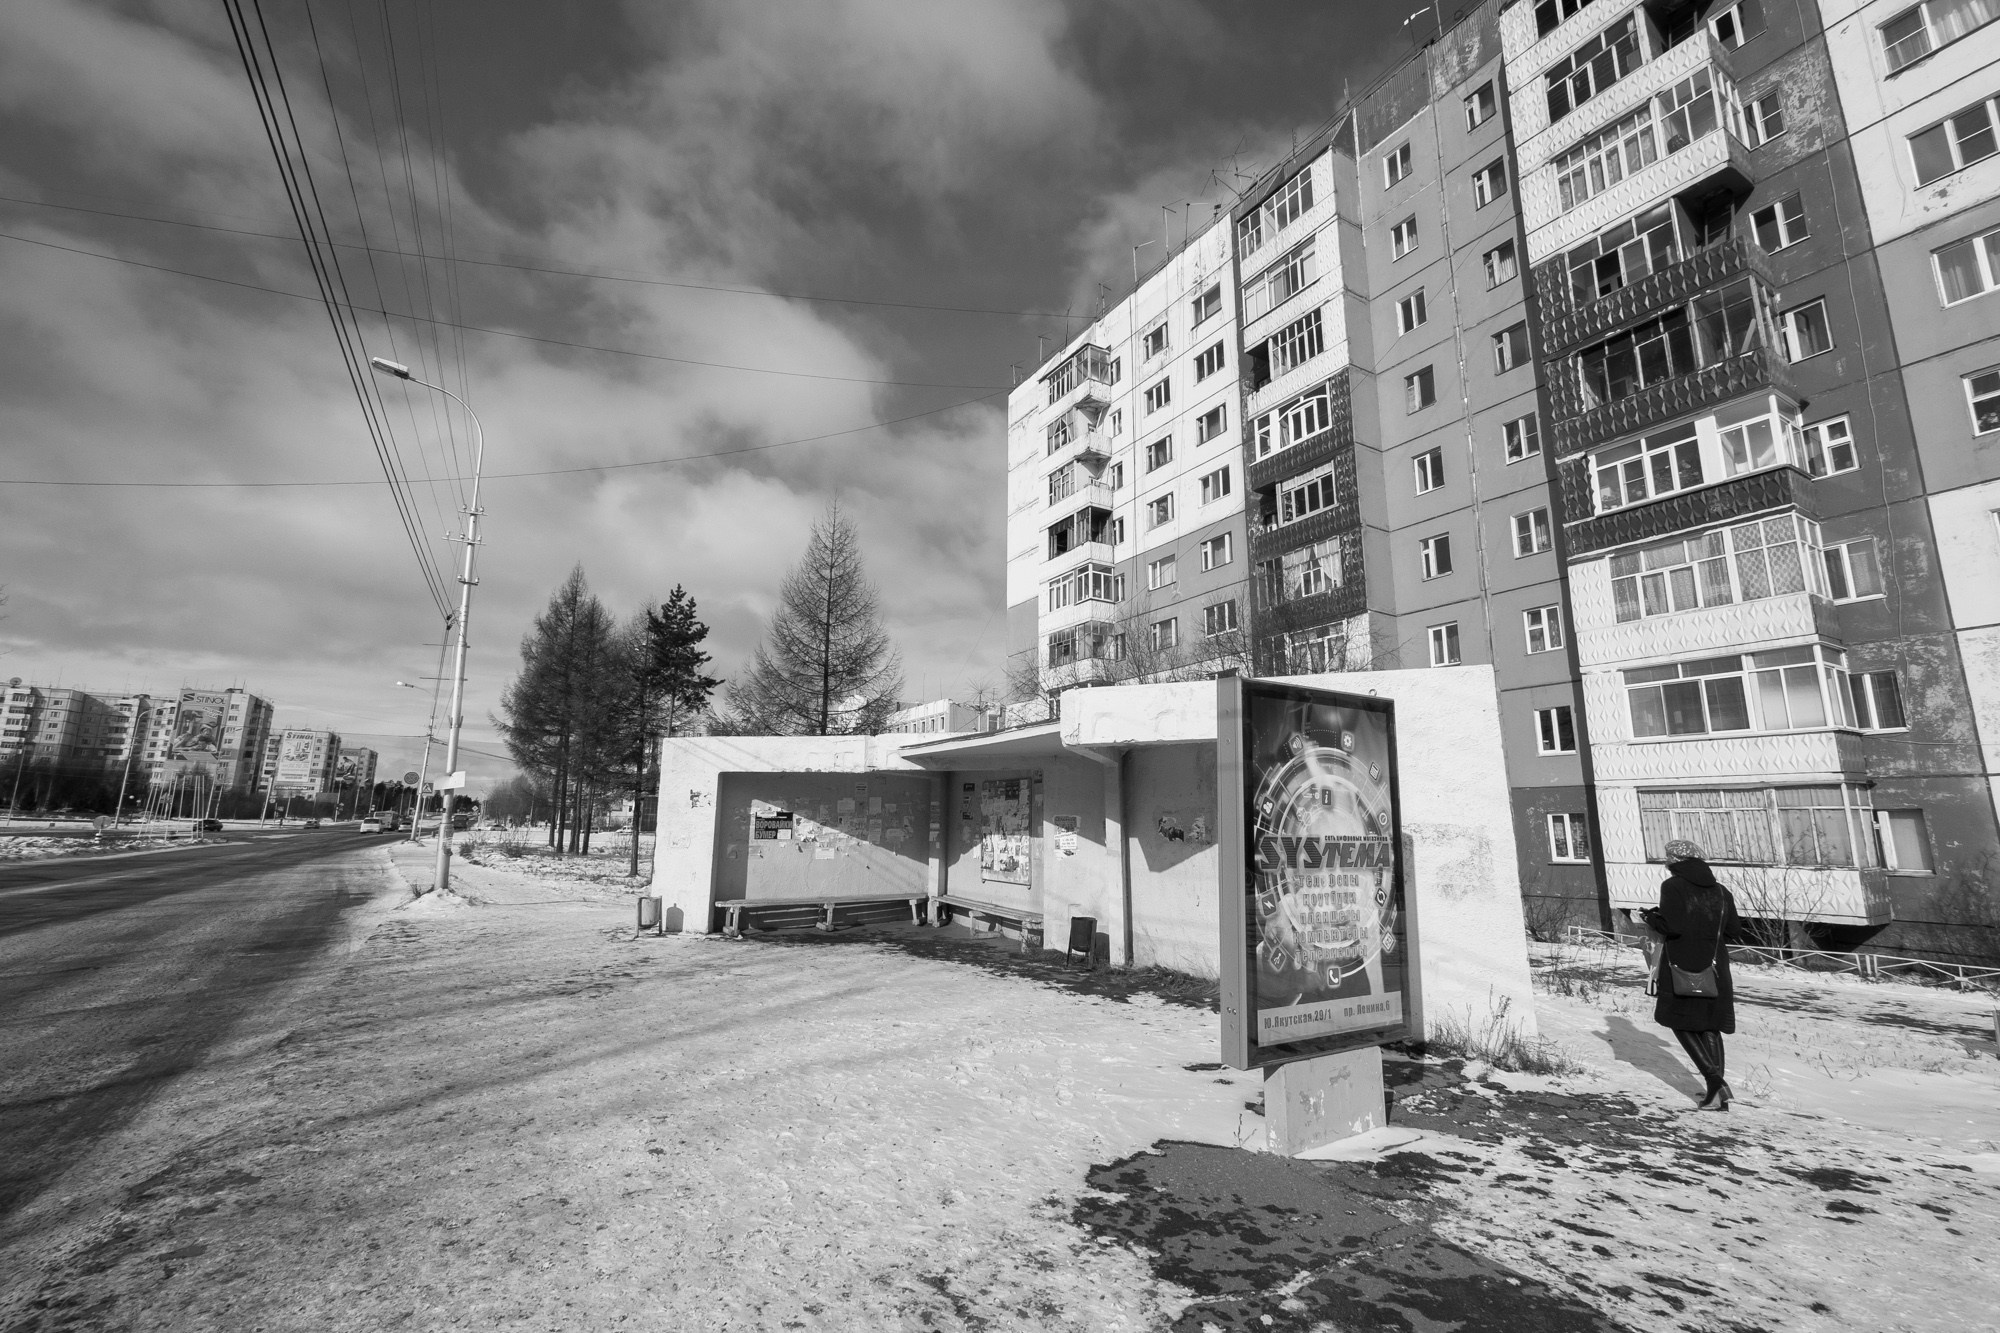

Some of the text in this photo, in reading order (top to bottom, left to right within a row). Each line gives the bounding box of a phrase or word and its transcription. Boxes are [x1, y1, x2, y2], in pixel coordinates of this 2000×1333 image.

[196, 695, 226, 705] STINOL
[755, 819, 793, 829] ВОРОВАЙКИ
[755, 830, 777, 839] БУМЕР
[1259, 836, 1391, 869] SYSTEMA
[1302, 890, 1357, 907] ноутбуки
[1299, 909, 1360, 925] планшеты
[1293, 926, 1369, 944] компьютеры
[1294, 944, 1368, 963] телевизоры
[1343, 1007, 1355, 1018] пр.
